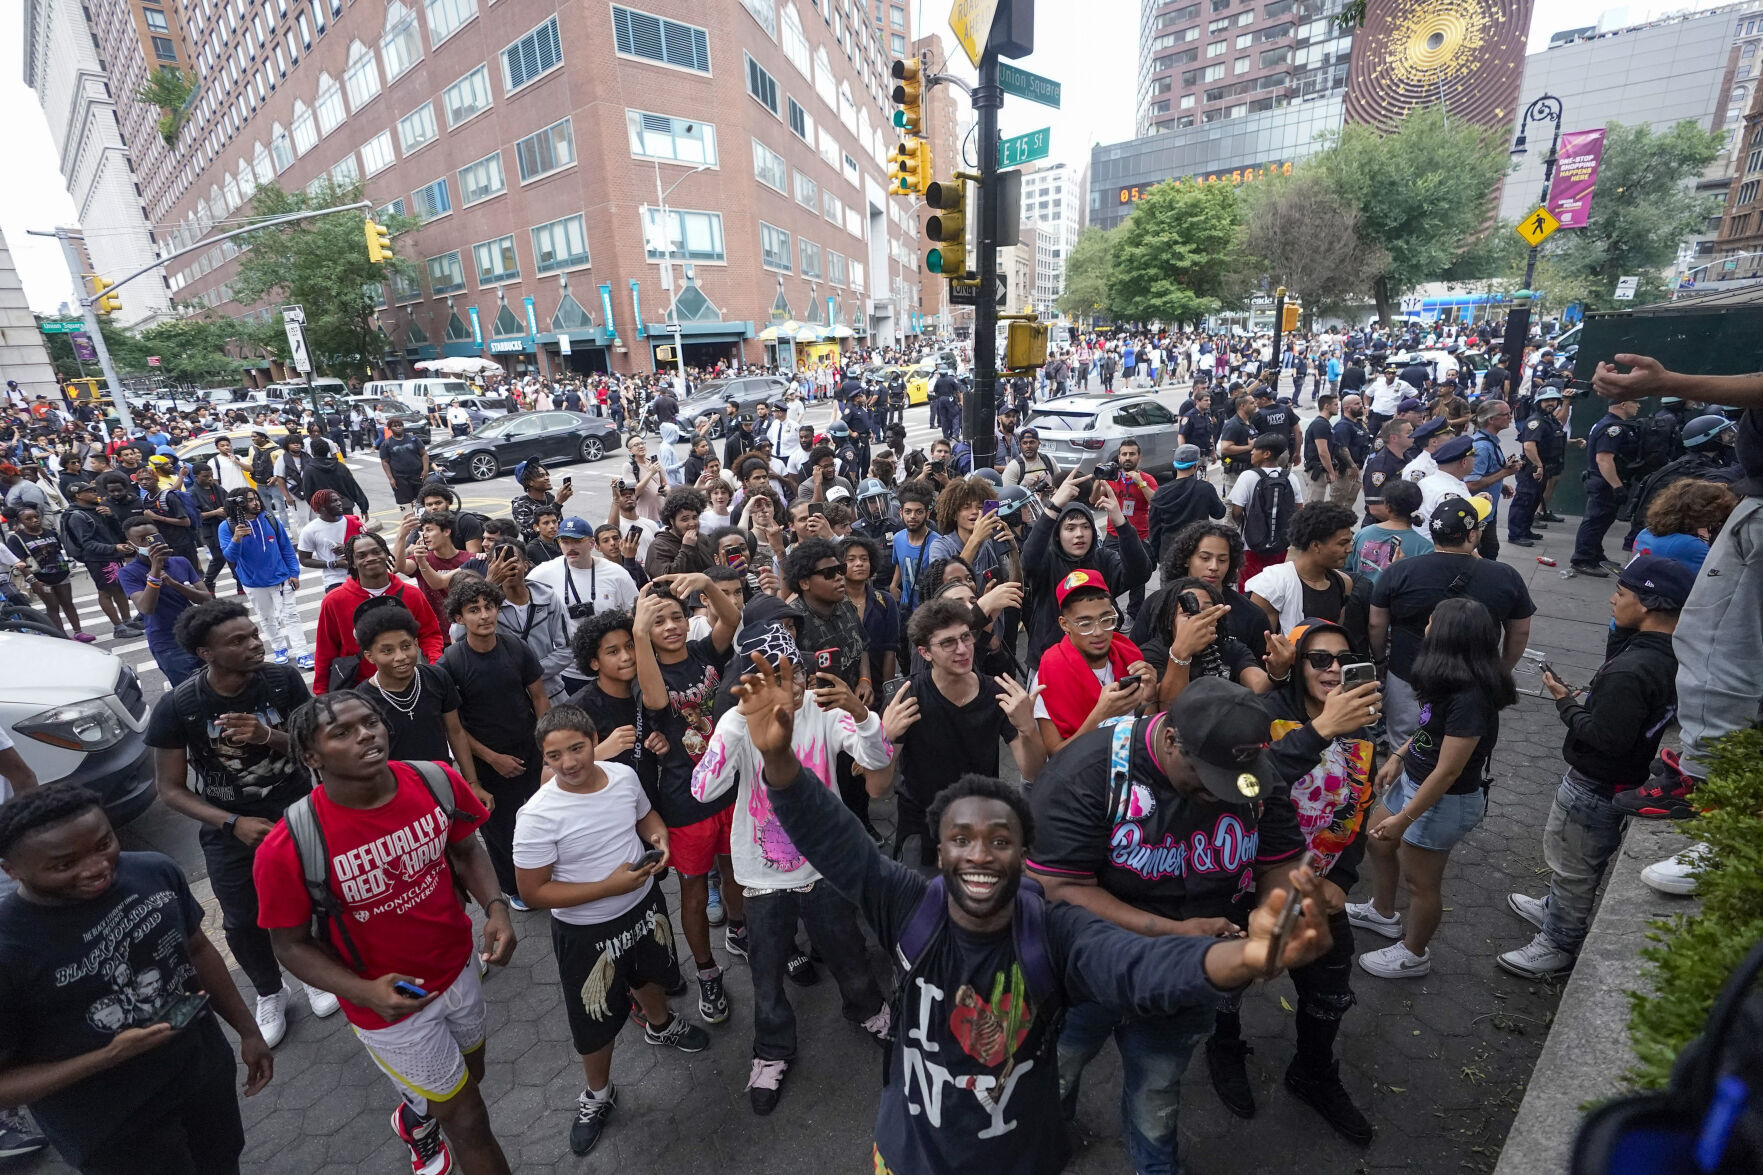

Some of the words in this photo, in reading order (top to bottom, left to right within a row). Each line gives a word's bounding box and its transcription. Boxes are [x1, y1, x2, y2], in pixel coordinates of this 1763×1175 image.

[1000, 66, 1026, 88] Union
[1029, 76, 1060, 98] Square
[1003, 142, 1011, 165] E
[1016, 137, 1028, 161] 15
[1559, 154, 1595, 166] ONE-STOP
[1560, 160, 1597, 171] SHOPPING
[1560, 167, 1592, 177] HAPPENS
[1571, 174, 1590, 182] HERE
[490, 340, 523, 353] STARBUCKS
[1267, 412, 1286, 422] NYPD
[333, 813, 435, 881] OFFICIALLY
[433, 805, 449, 831] A
[1191, 831, 1220, 874] &
[341, 868, 386, 903] RED
[373, 874, 432, 915] MONTCLAIR
[396, 875, 440, 915] UNIVERSITY
[132, 911, 162, 943] 2019
[908, 976, 945, 1052] I
[903, 1044, 1035, 1140] NY
